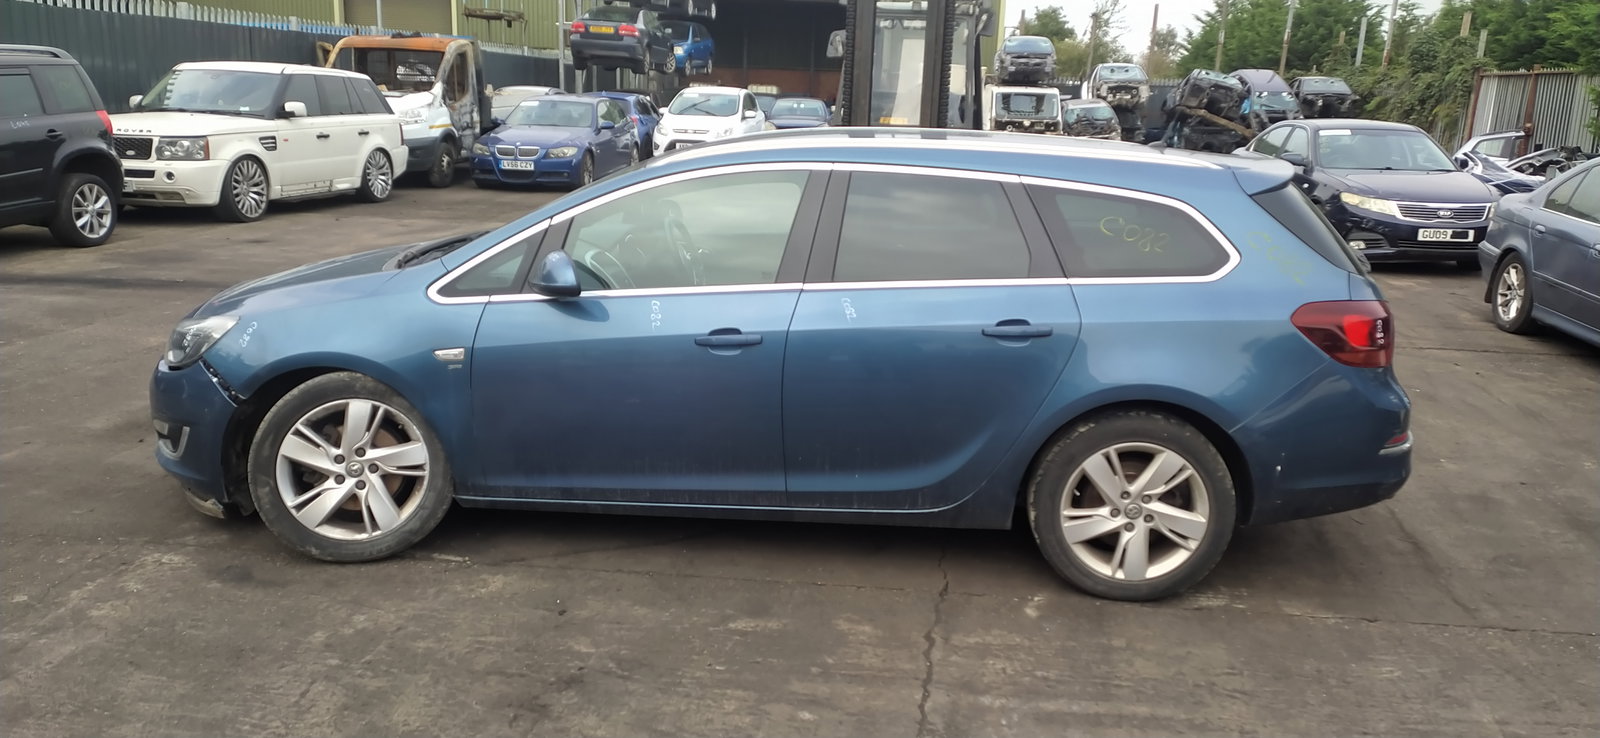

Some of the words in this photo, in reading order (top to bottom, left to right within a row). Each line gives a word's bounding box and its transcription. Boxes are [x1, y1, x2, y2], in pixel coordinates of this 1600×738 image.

[519, 161, 533, 169] CZY
[1100, 216, 1169, 252] C082
[1422, 230, 1448, 239] GU09
[651, 300, 661, 330] C082
[240, 321, 257, 347] C082
[1376, 320, 1384, 344] C082
